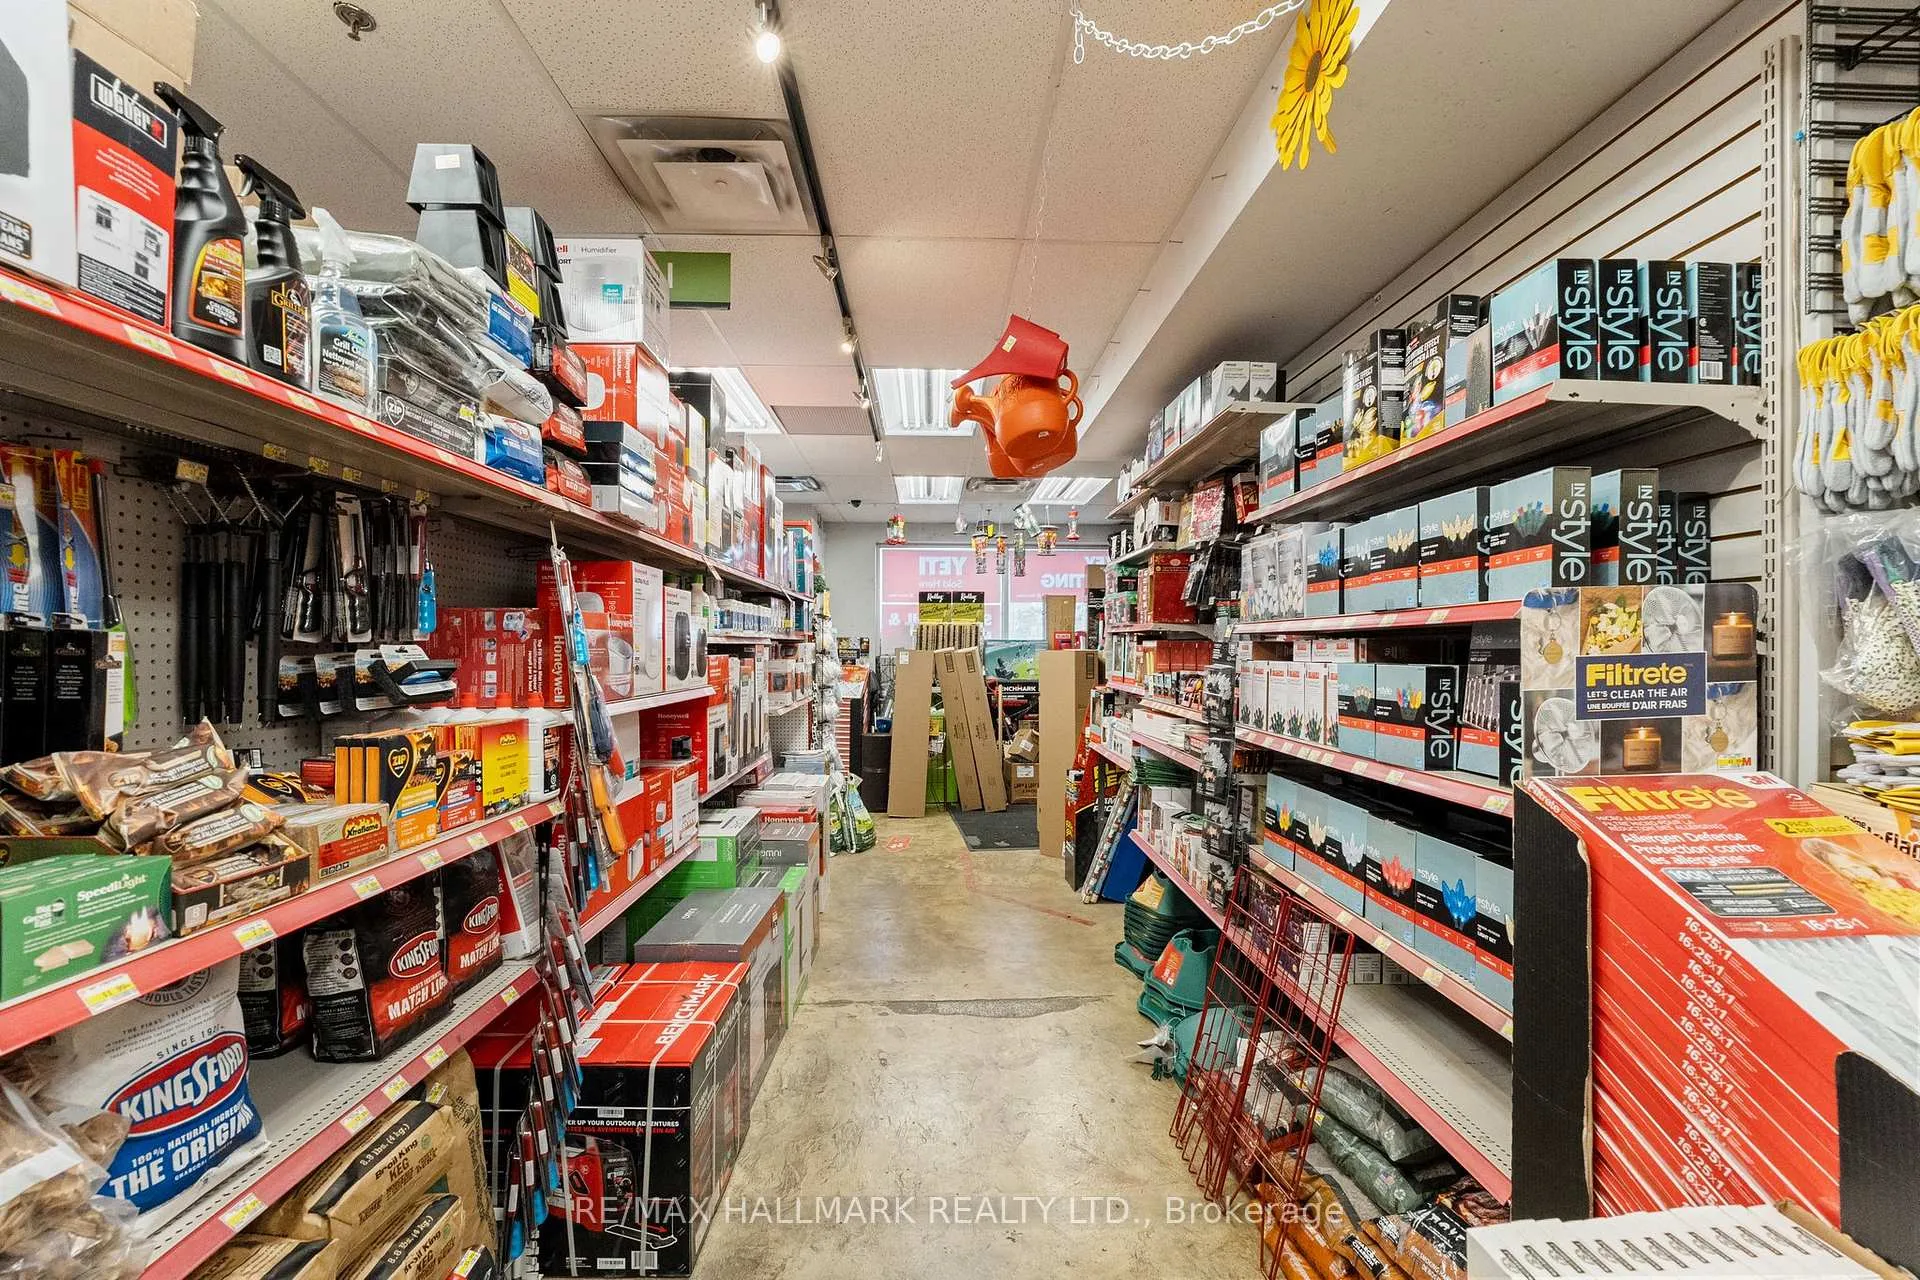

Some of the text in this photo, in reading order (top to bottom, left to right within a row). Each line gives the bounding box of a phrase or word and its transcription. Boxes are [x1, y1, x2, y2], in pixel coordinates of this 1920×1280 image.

[97, 79, 150, 129] weber
[580, 246, 617, 255] Humidifier
[1557, 270, 1597, 372] IN Style
[1598, 269, 1640, 371] IN Style
[1649, 270, 1689, 372] IN Style
[387, 401, 403, 414] ZIP
[1552, 482, 1592, 582] IN Style
[1618, 484, 1658, 583] IN Style
[1678, 505, 1711, 585] IN Style
[551, 634, 565, 703] Honeywell
[1585, 662, 1689, 688] Filtrete
[1586, 687, 1688, 700] LET'S CLEAR THE AIR
[1632, 699, 1658, 711] D'AIR
[1659, 699, 1688, 710] FRAIS
[1425, 678, 1456, 760] IN Style
[393, 754, 407, 767] ZIP
[1563, 785, 1759, 814] Filtrete
[1622, 831, 1748, 845] Allergen Defense
[1631, 844, 1765, 856] Protection contre
[1648, 855, 1668, 865] les
[460, 946, 489, 969] MATCH
[1678, 931, 1726, 977] 16x25x1
[1685, 916, 1733, 961] 16x25x1
[144, 993, 183, 1004] HOULD
[388, 988, 430, 1021] MATCH
[1680, 973, 1728, 1021] 16x25x1
[1687, 959, 1737, 1006] 16x25x1
[655, 972, 719, 1047] BENCHMARK
[1686, 1000, 1735, 1050] 16x25x1
[156, 1034, 196, 1060] SINCE
[1680, 1015, 1728, 1065] 16x25x1
[119, 1042, 245, 1125] KINGSFORD
[1681, 1059, 1729, 1110] 16x25x1
[1686, 1043, 1735, 1096] 16x25x1
[637, 1120, 680, 1128] ADENTURES
[1683, 1084, 1733, 1138] 16x25x1
[132, 1147, 166, 1168] 100%
[167, 1122, 210, 1152] NATURAL
[374, 1138, 419, 1181] Broil King
[1678, 1135, 1726, 1191] 16x25x1
[1684, 1123, 1733, 1178] 16x25x1
[109, 1157, 167, 1201] THE
[390, 1157, 411, 1183] KEG
[1681, 1164, 1718, 1206] 16x25
[422, 1230, 442, 1252] King
